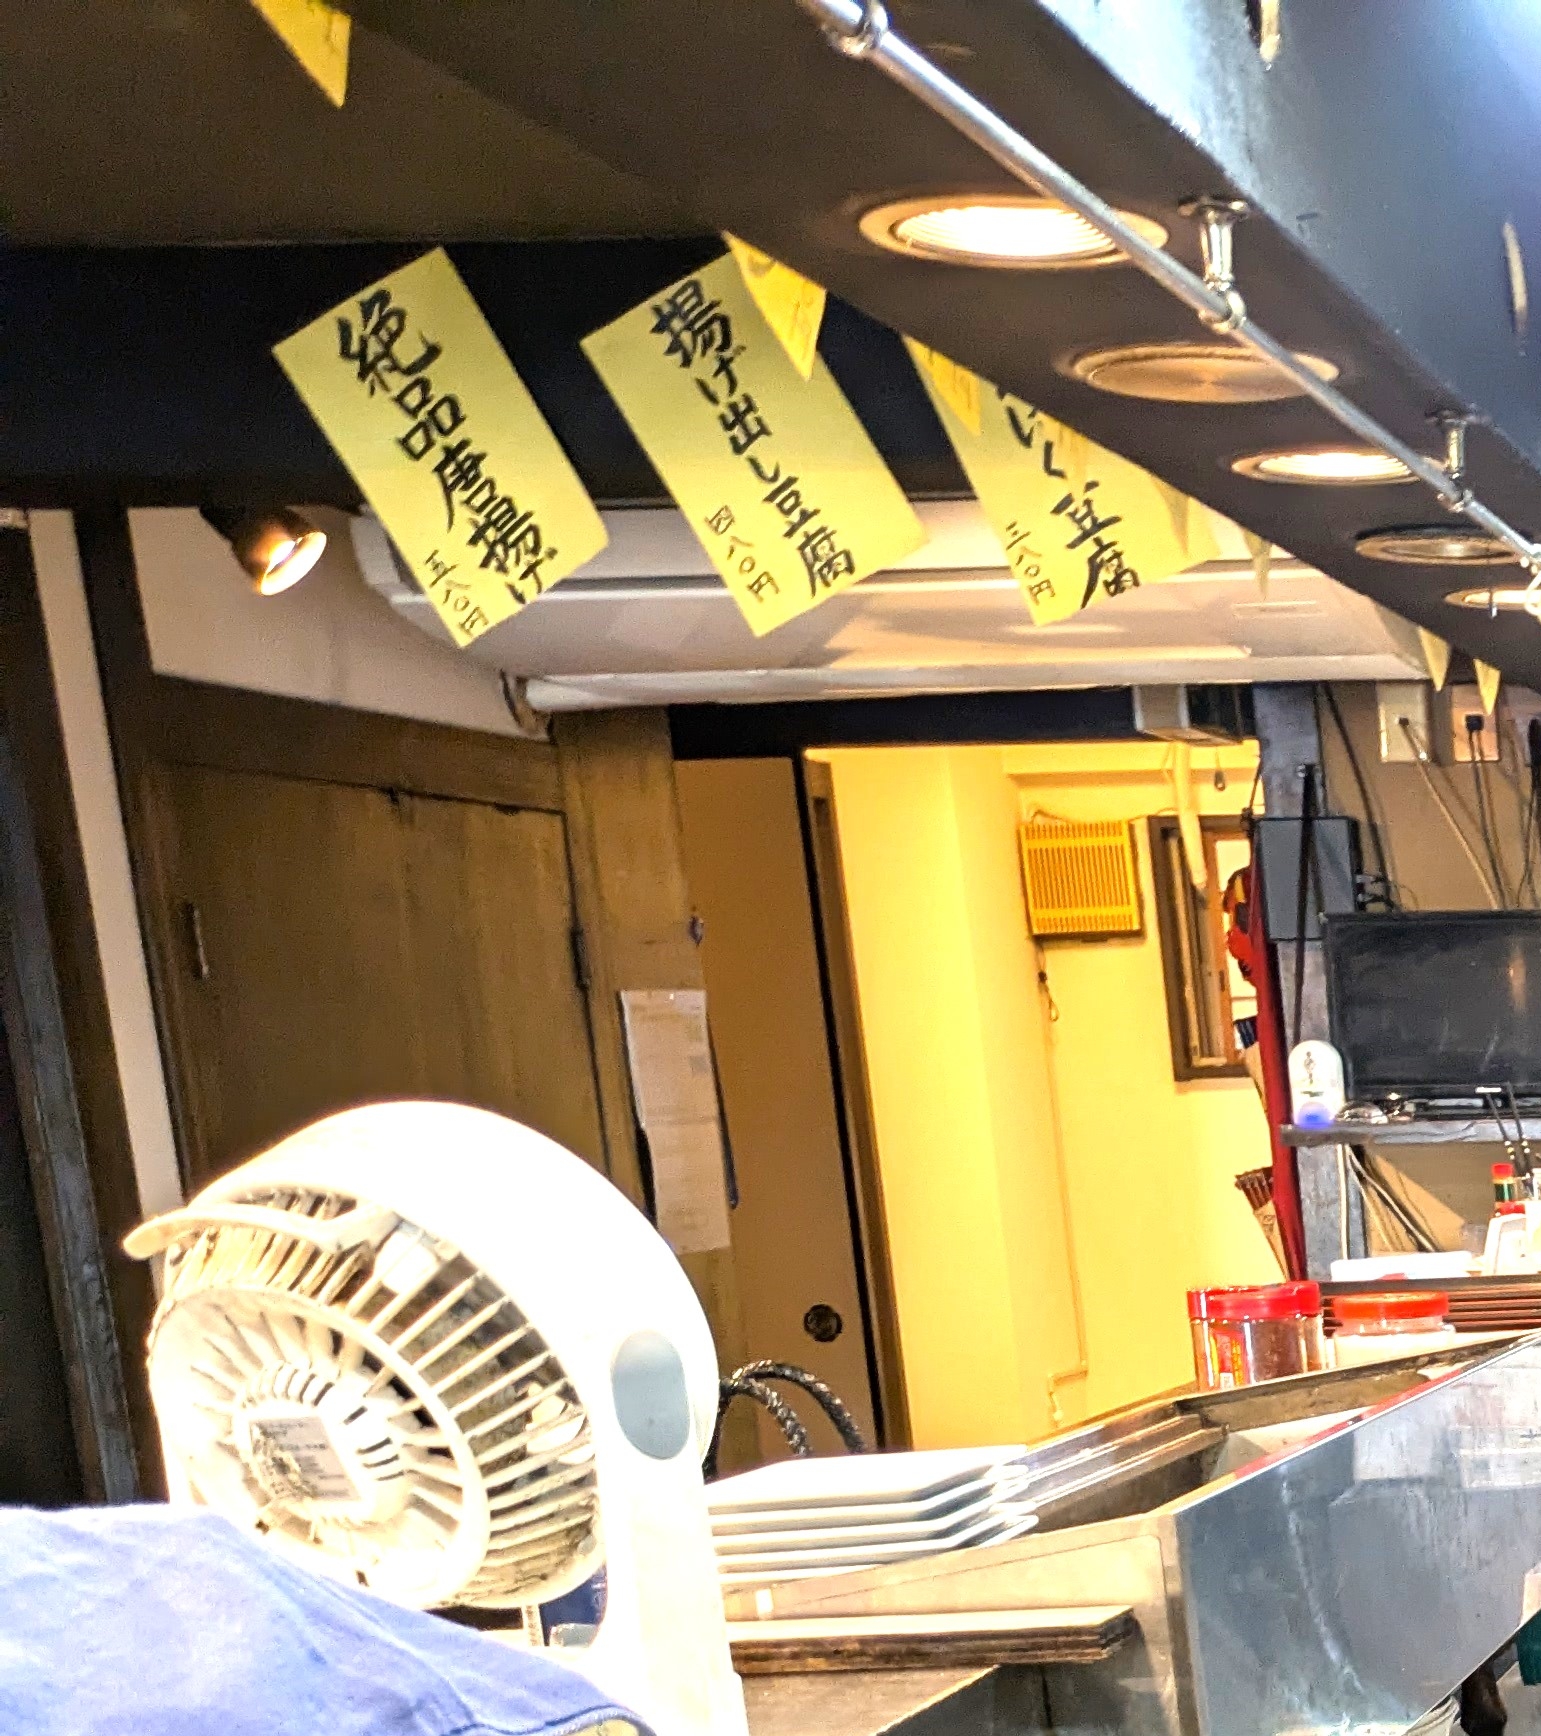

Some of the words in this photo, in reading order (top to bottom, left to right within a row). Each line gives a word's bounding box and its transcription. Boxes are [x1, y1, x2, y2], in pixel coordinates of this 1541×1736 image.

[338, 288, 558, 605] 絶品唐揚げ
[650, 279, 856, 599] 揚げ出し豆腐
